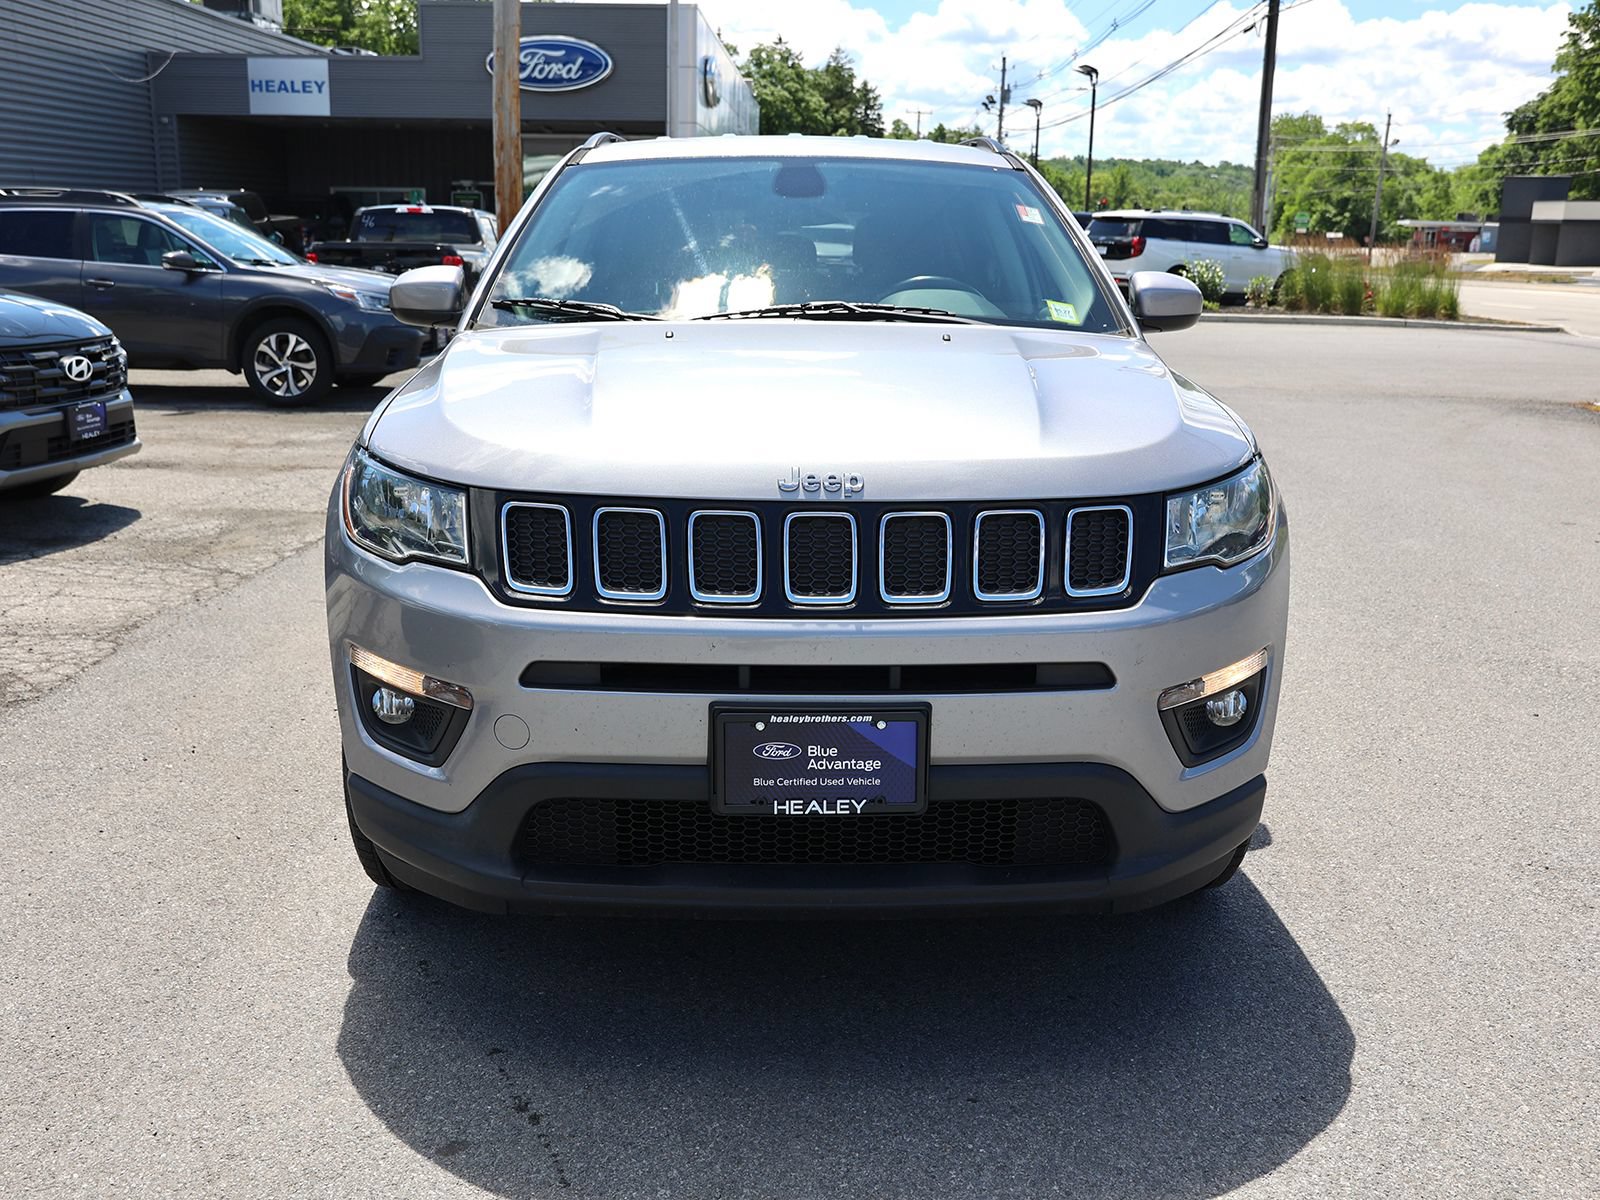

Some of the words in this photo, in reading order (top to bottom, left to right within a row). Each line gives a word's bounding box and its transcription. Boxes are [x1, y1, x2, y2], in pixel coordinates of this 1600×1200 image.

[519, 49, 585, 80] Ford
[250, 79, 326, 94] HEALEY
[777, 466, 865, 498] Jeep
[769, 714, 873, 724] healeybrothers.com
[762, 744, 793, 757] Ford
[807, 745, 838, 757] Blue
[807, 758, 881, 771] Advantage
[753, 777, 775, 786] Blue
[776, 777, 818, 786] Certified
[819, 777, 844, 786] Used
[846, 777, 881, 786] Vehicle
[773, 799, 867, 815] HEALEY
